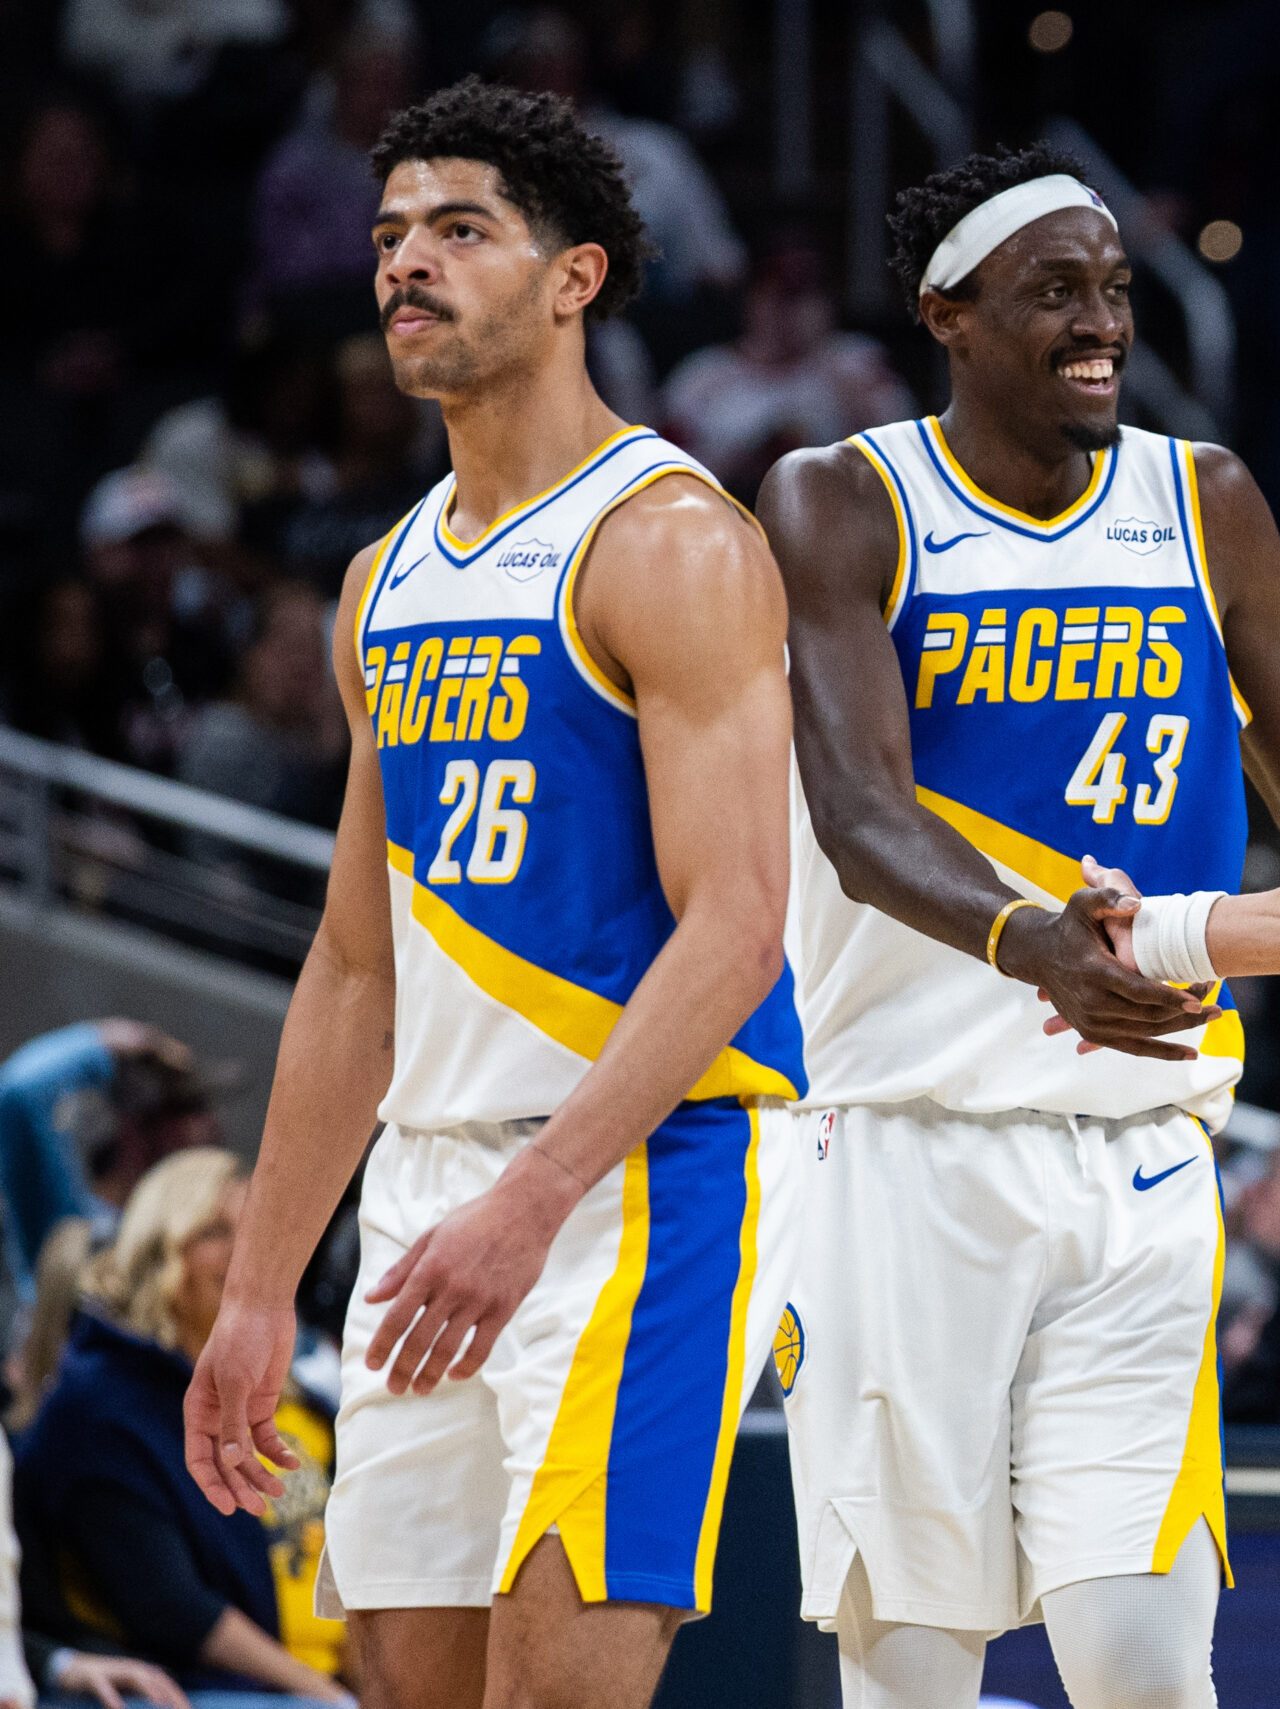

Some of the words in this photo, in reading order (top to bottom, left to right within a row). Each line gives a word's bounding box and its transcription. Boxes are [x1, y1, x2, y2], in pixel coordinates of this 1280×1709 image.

[496, 552, 540, 568] LUCAS
[539, 552, 562, 568] OIL
[1106, 527, 1148, 543] LUCAS
[1152, 526, 1176, 543] OIL
[365, 634, 542, 749] PACERS
[915, 605, 1187, 709] PACERS
[427, 759, 536, 885] 26
[1064, 712, 1190, 825] 43
